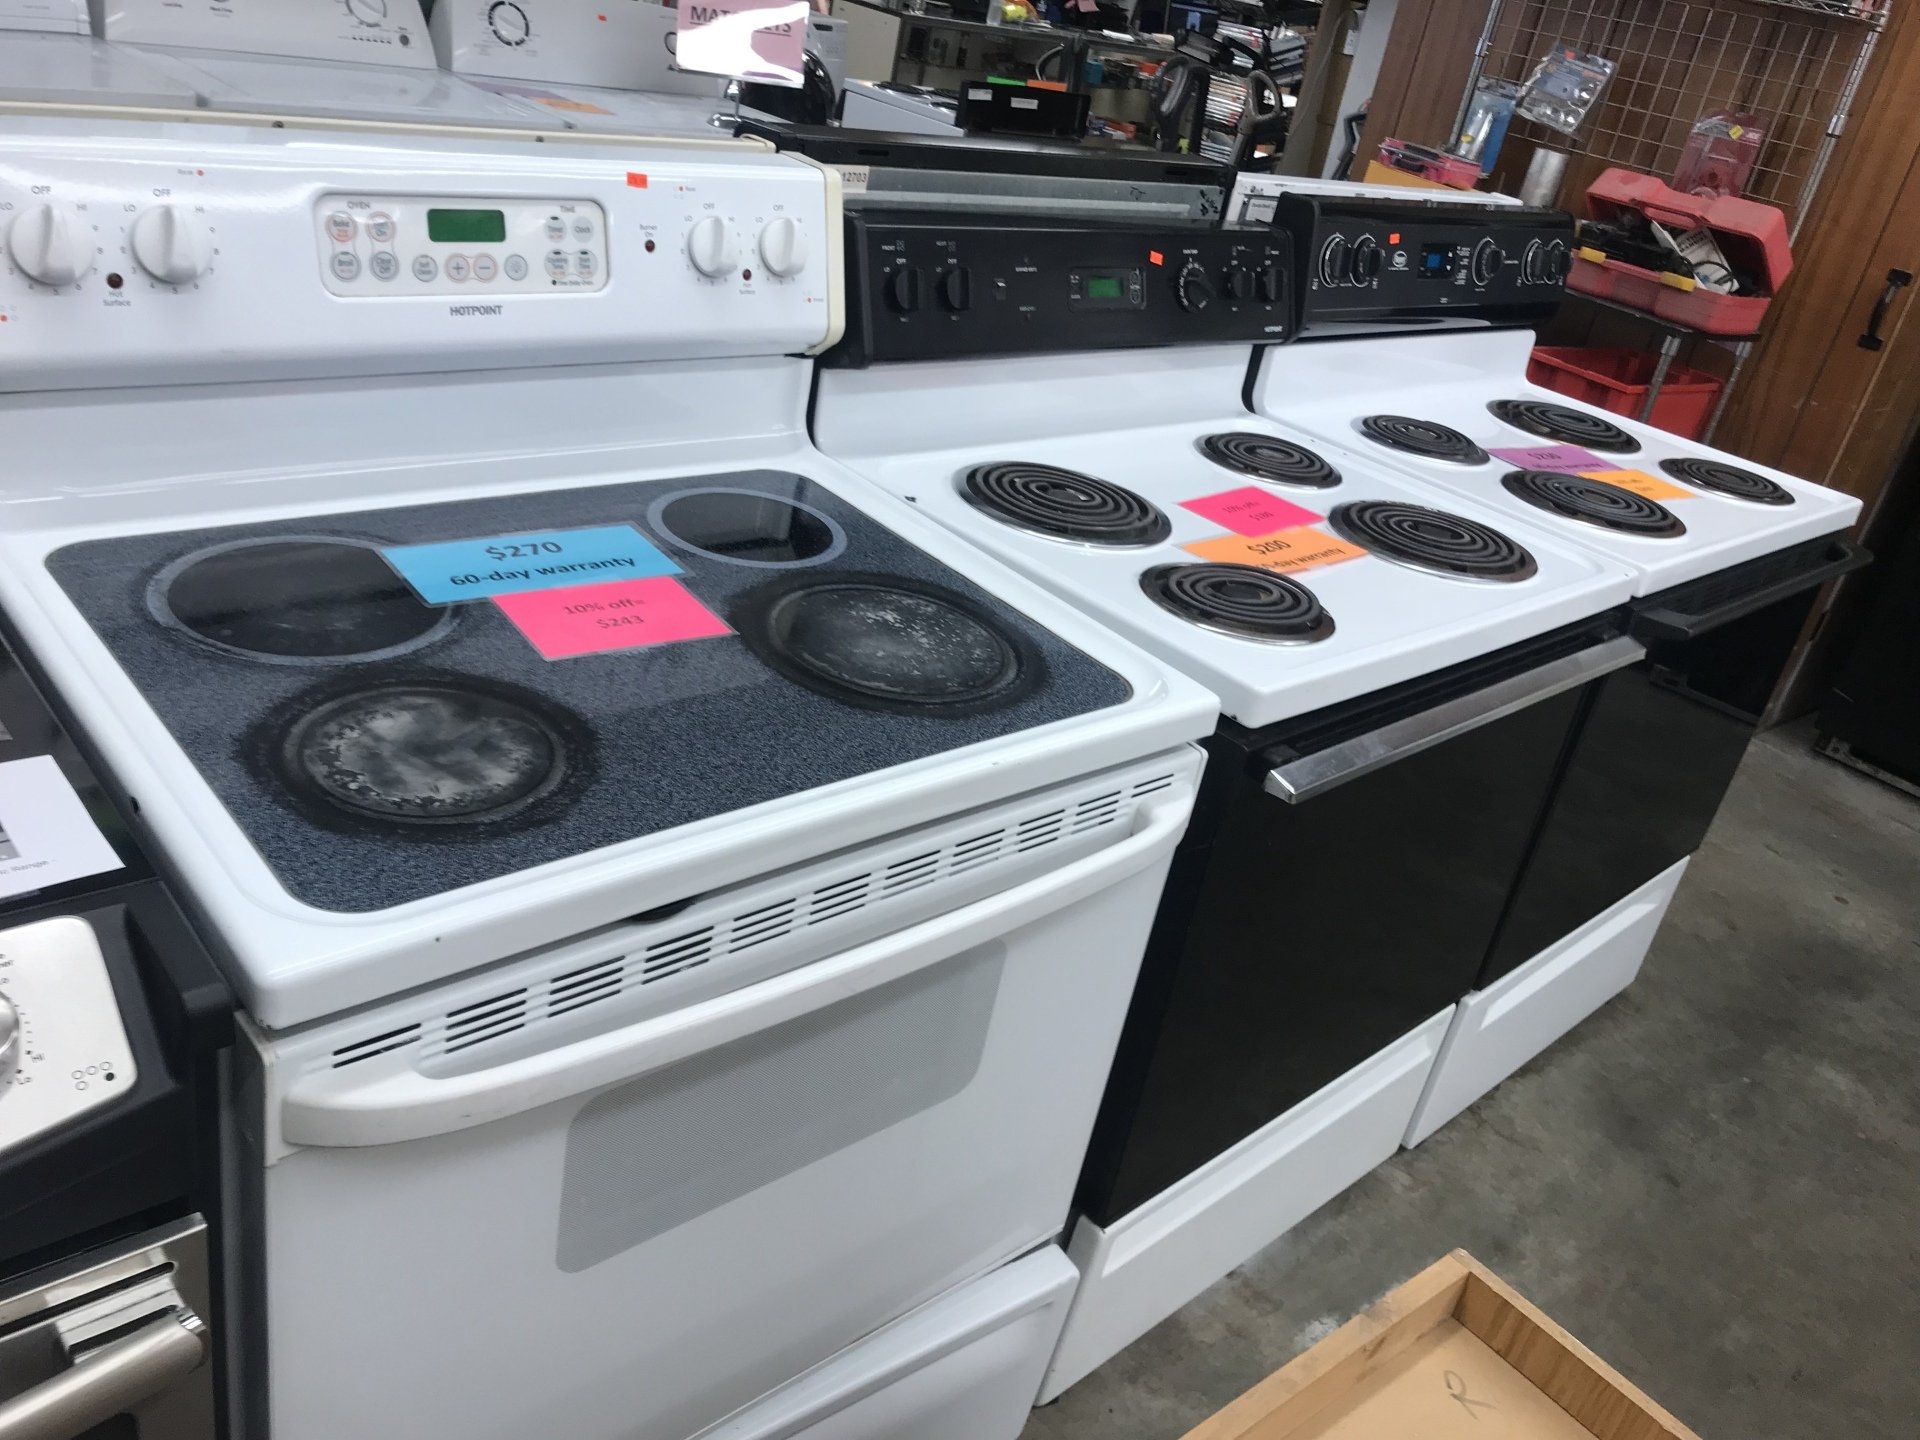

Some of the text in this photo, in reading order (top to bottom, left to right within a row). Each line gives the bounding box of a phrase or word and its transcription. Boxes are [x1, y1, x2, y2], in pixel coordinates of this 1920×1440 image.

[31, 185, 51, 195] OFF
[152, 188, 171, 197] OFF
[123, 204, 136, 213] LO
[450, 305, 503, 317] HOTPOINT
[485, 540, 563, 561] $270
[1247, 539, 1292, 557] $200
[1256, 547, 1347, 572] 0-day warranty
[450, 556, 636, 587] 60-day warranty
[564, 600, 606, 615] 10%
[596, 614, 645, 630] $243
